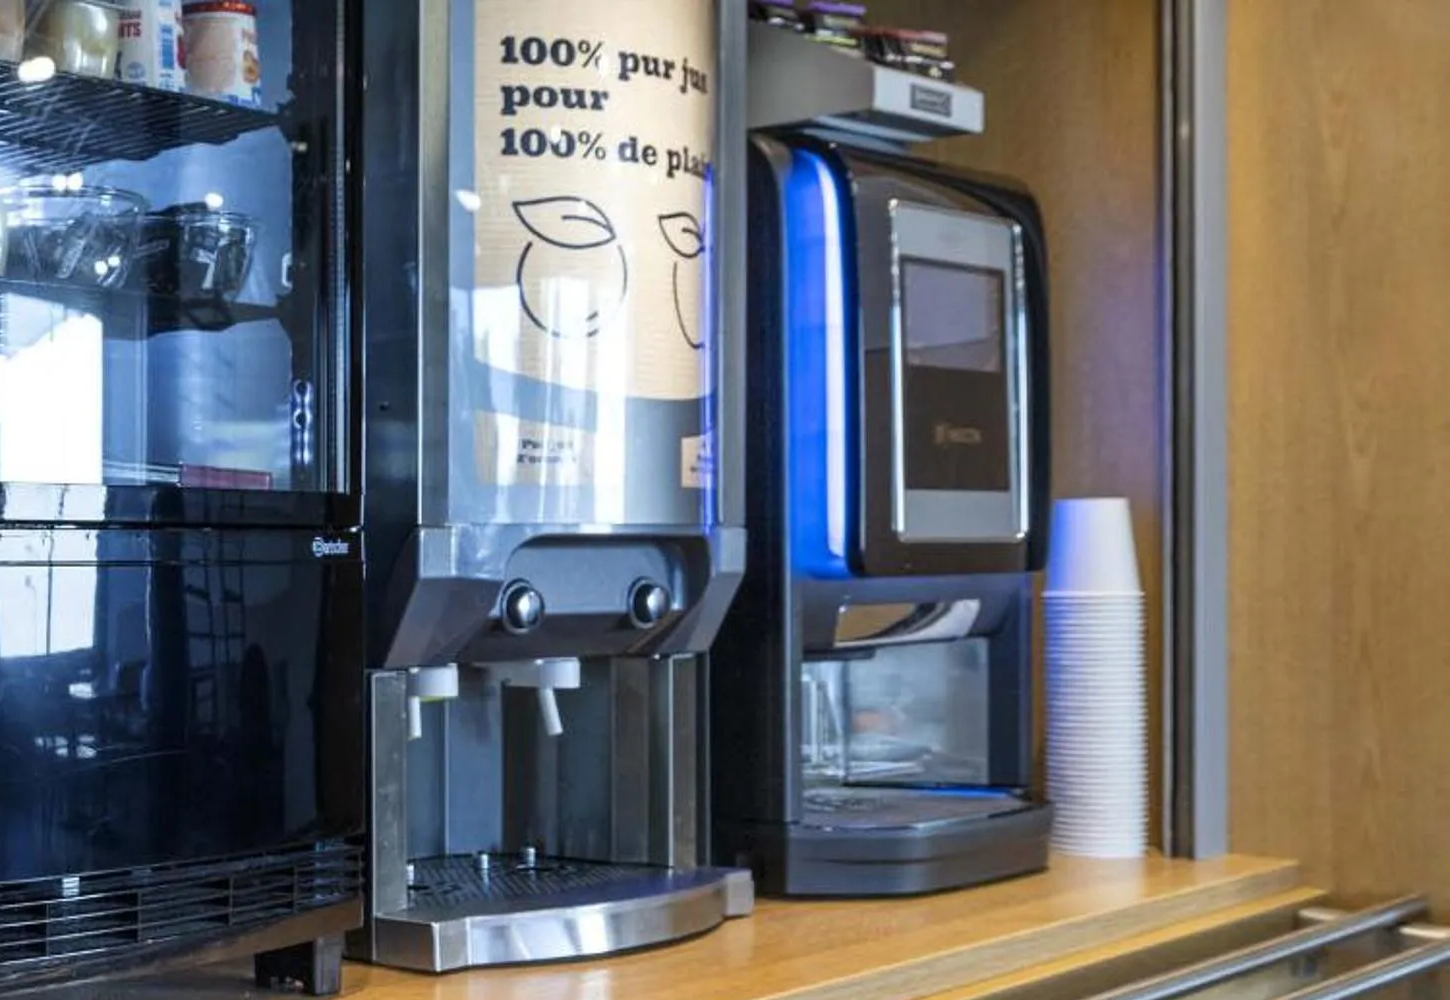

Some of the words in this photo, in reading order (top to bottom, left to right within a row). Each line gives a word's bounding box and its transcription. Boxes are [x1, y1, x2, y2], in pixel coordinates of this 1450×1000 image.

[500, 36, 606, 69] 100%
[618, 51, 675, 81] pur
[679, 58, 708, 94] jus
[500, 84, 610, 116] pour
[500, 127, 607, 161] 100%
[618, 136, 657, 166] de
